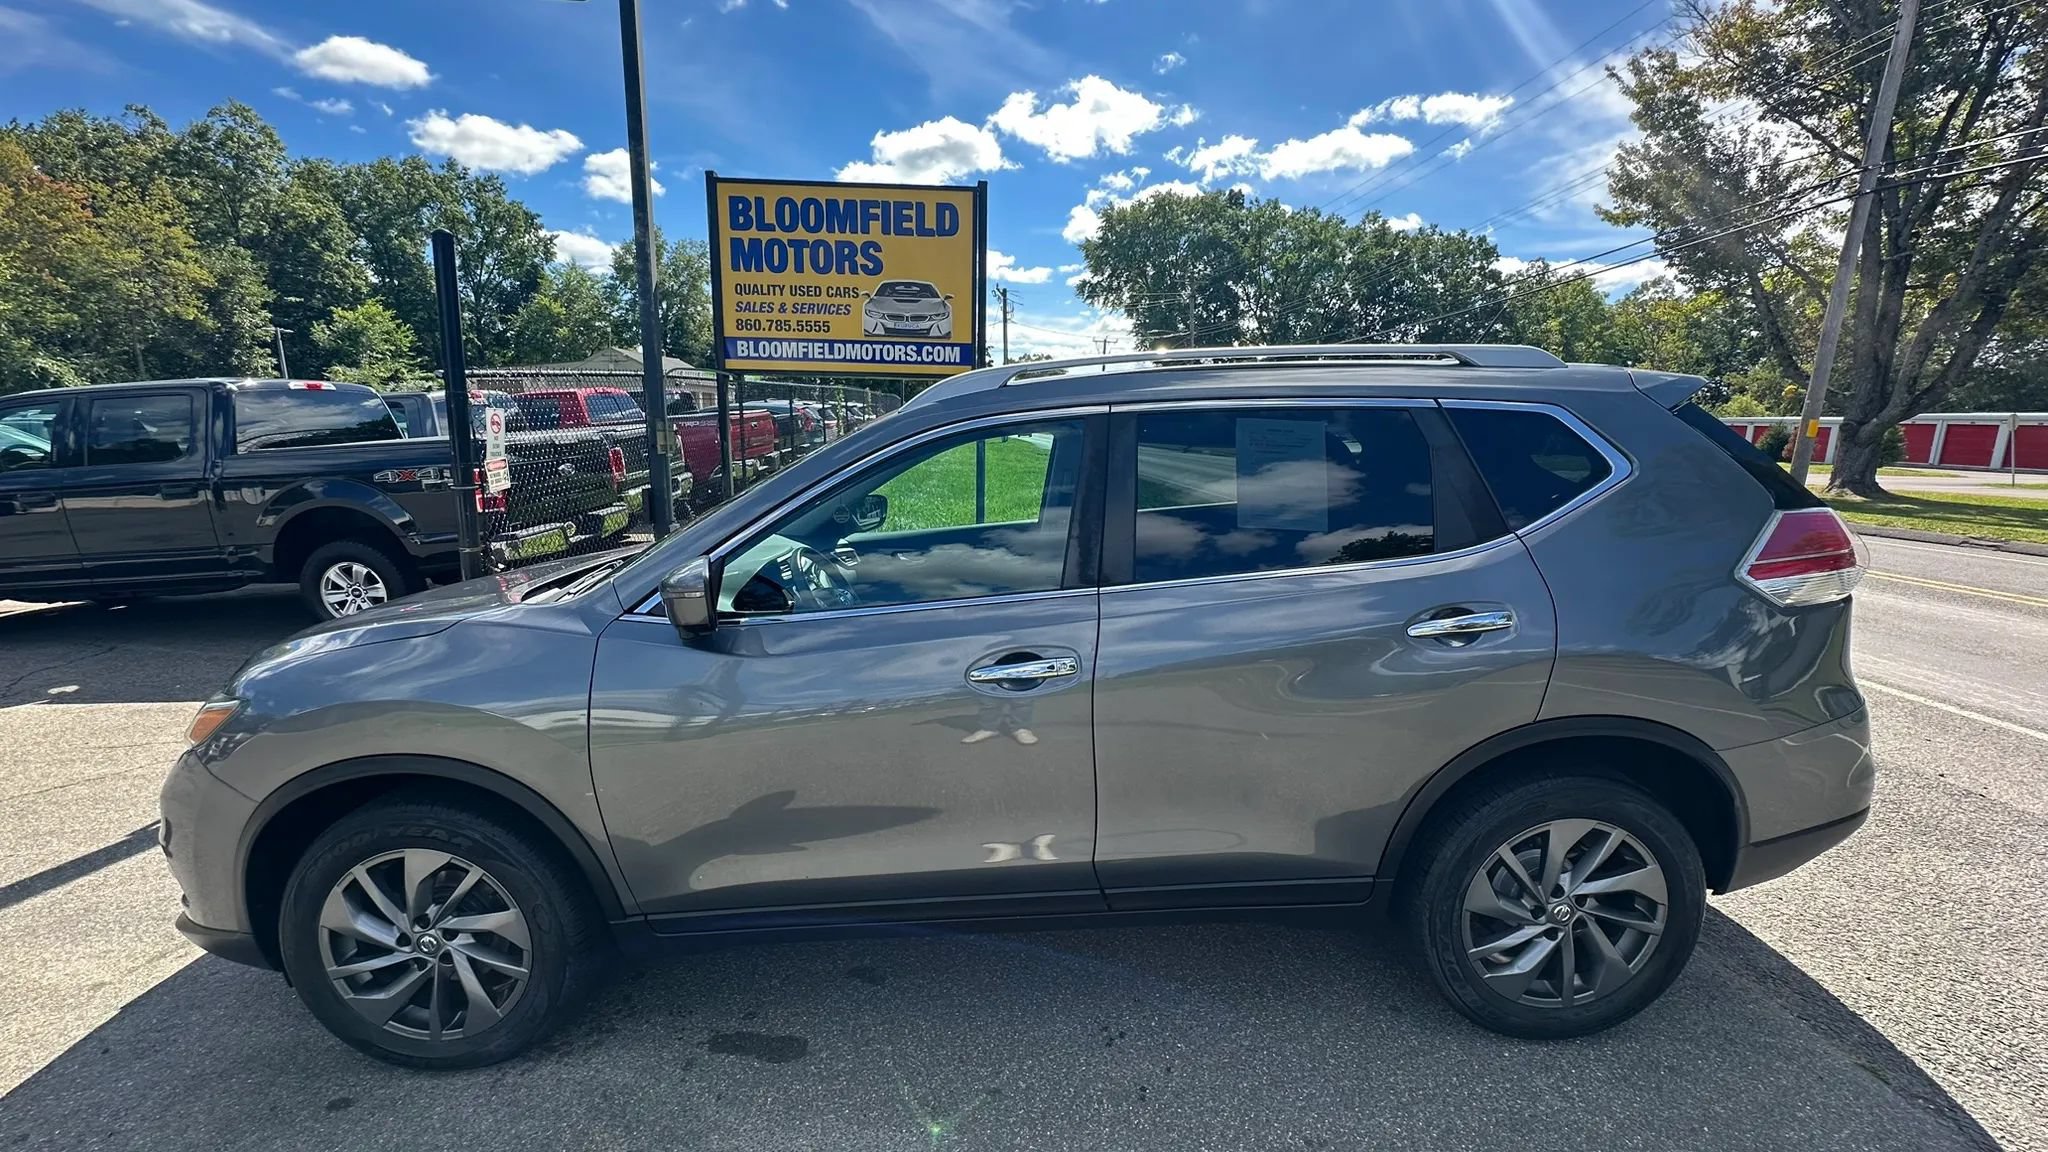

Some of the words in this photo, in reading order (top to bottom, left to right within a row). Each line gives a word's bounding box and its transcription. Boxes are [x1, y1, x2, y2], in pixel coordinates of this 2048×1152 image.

[728, 195, 960, 237] BLOOMFIELD
[730, 237, 884, 276] MOTORS
[735, 283, 785, 297] QUALITY
[790, 285, 822, 298] USED
[826, 286, 859, 299] CARS
[735, 301, 774, 315] SALES
[778, 302, 788, 315] &
[791, 302, 851, 316] SERVICES
[735, 318, 831, 333] 860.785.5555
[736, 340, 961, 363] BLOOMFIELDMOTORS.COM
